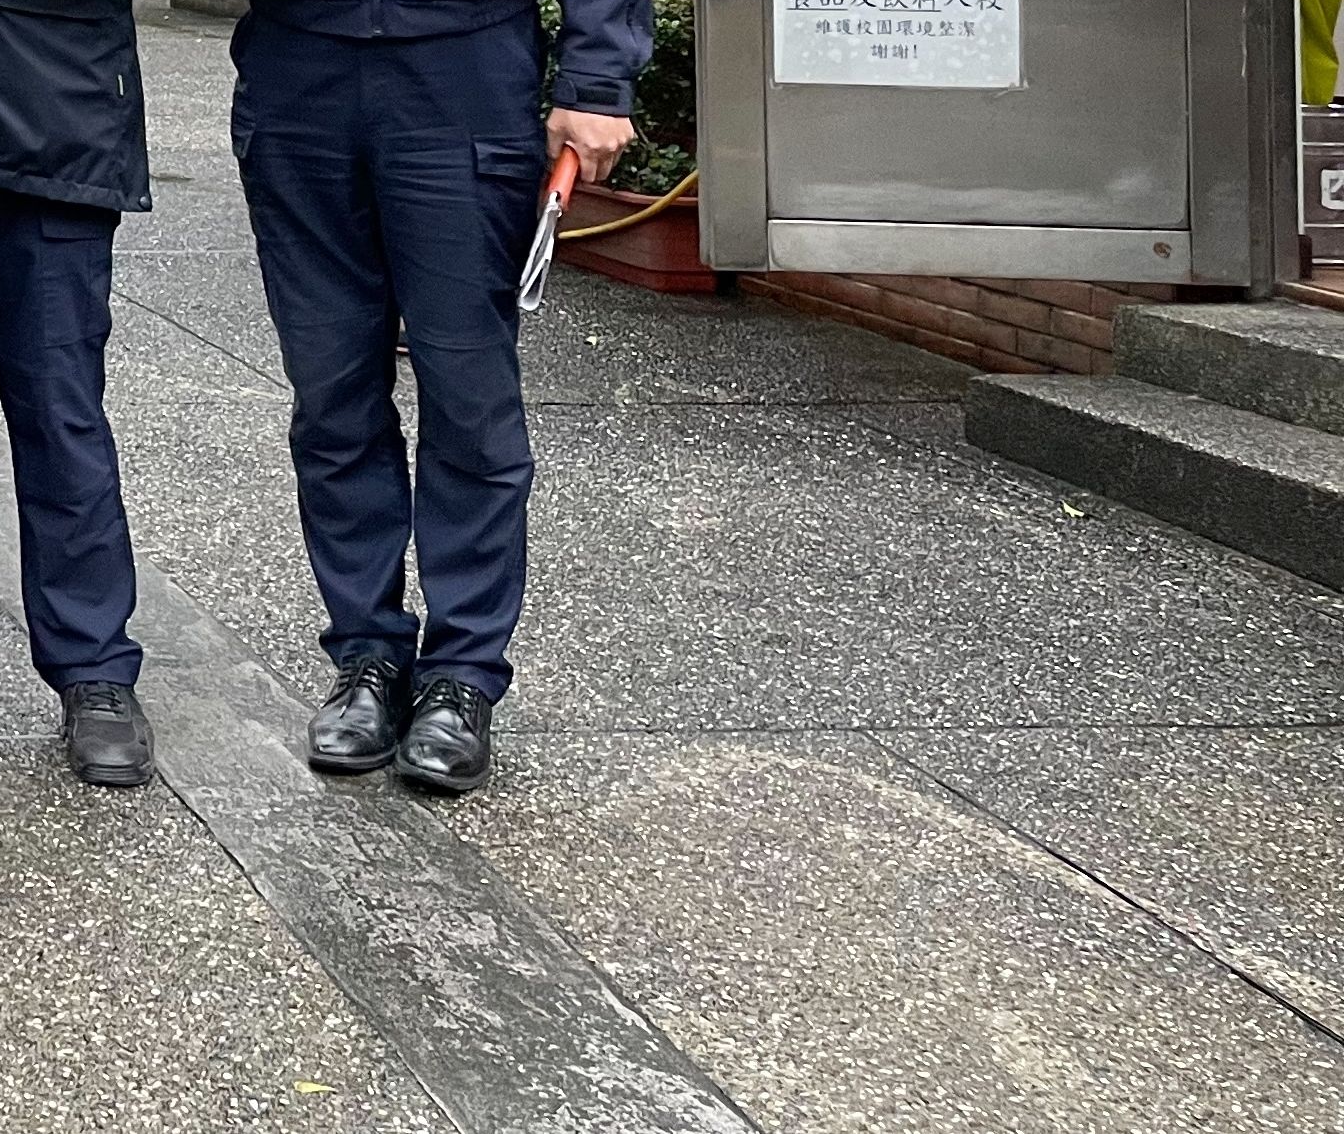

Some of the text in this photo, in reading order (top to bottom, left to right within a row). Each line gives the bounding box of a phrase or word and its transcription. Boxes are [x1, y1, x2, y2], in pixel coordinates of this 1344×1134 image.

[815, 19, 976, 37] 維護校園環境整潔
